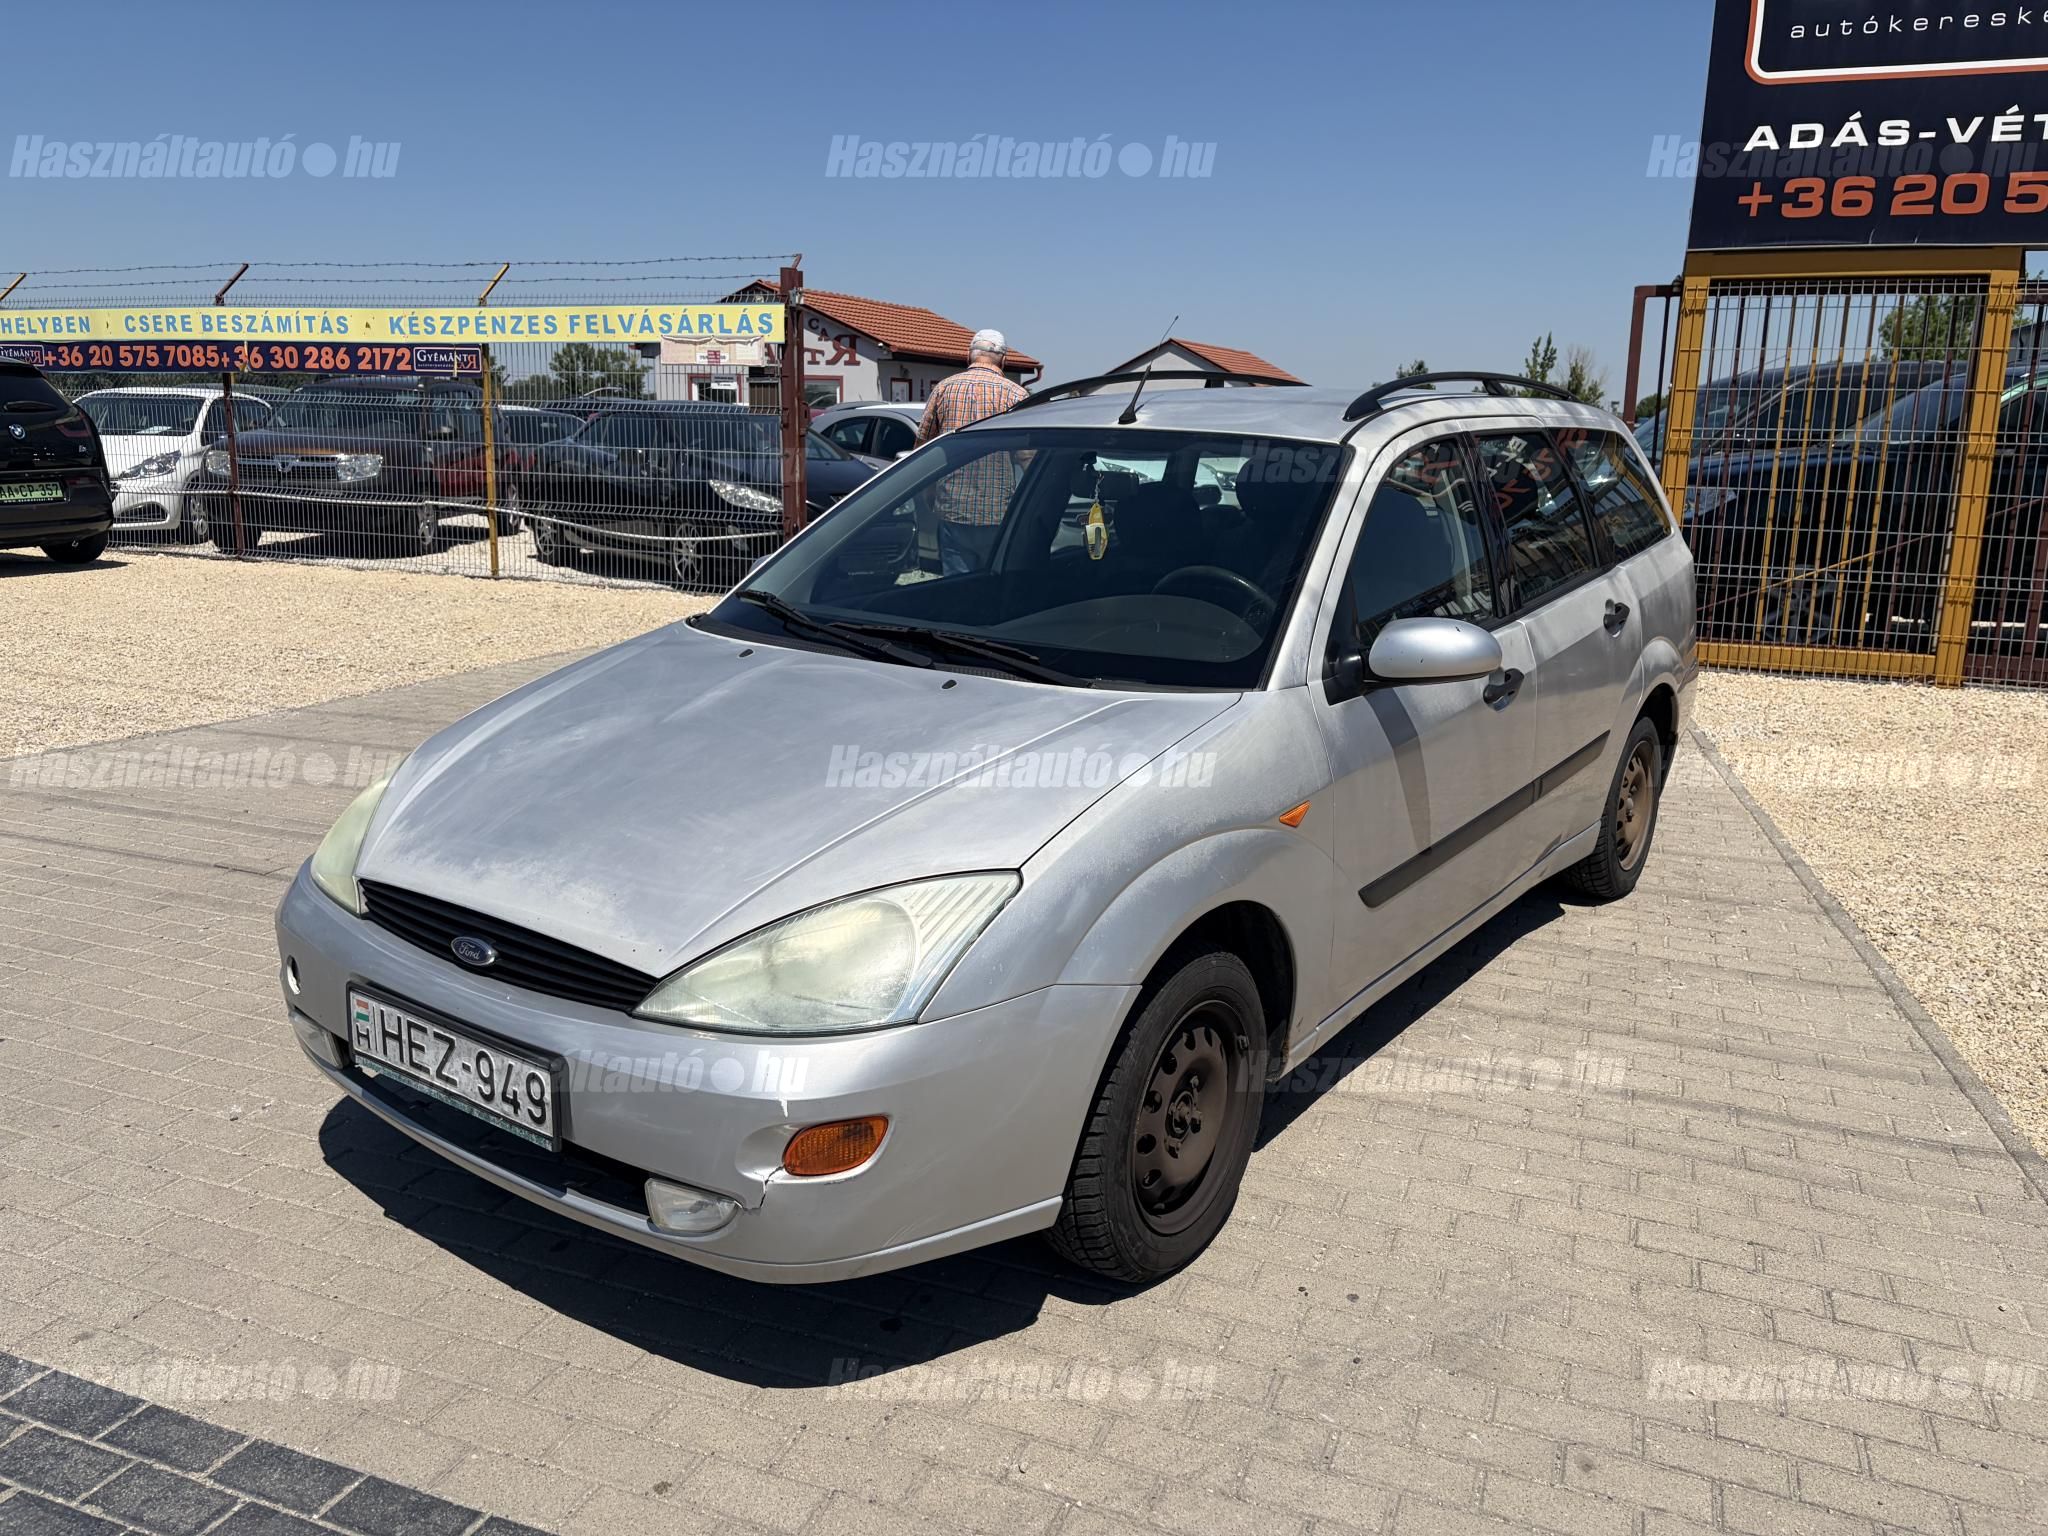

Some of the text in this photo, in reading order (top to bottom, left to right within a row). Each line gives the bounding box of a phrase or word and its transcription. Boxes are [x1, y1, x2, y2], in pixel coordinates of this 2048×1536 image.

[1738, 176, 1877, 219] +36
[1890, 172, 1991, 217] 20
[1, 307, 775, 336] HELYBEN CSERE BESZÁMÍTÁS KÉSZPÉNZES FELVÁSÁRLÁS
[88, 345, 114, 367] 20
[119, 345, 160, 368] 575
[163, 345, 219, 368] 7085
[269, 346, 299, 370] 30
[304, 346, 351, 371] 286
[357, 347, 413, 371] 2172
[459, 942, 481, 960] Ford
[380, 1007, 547, 1125] HEZ-949
